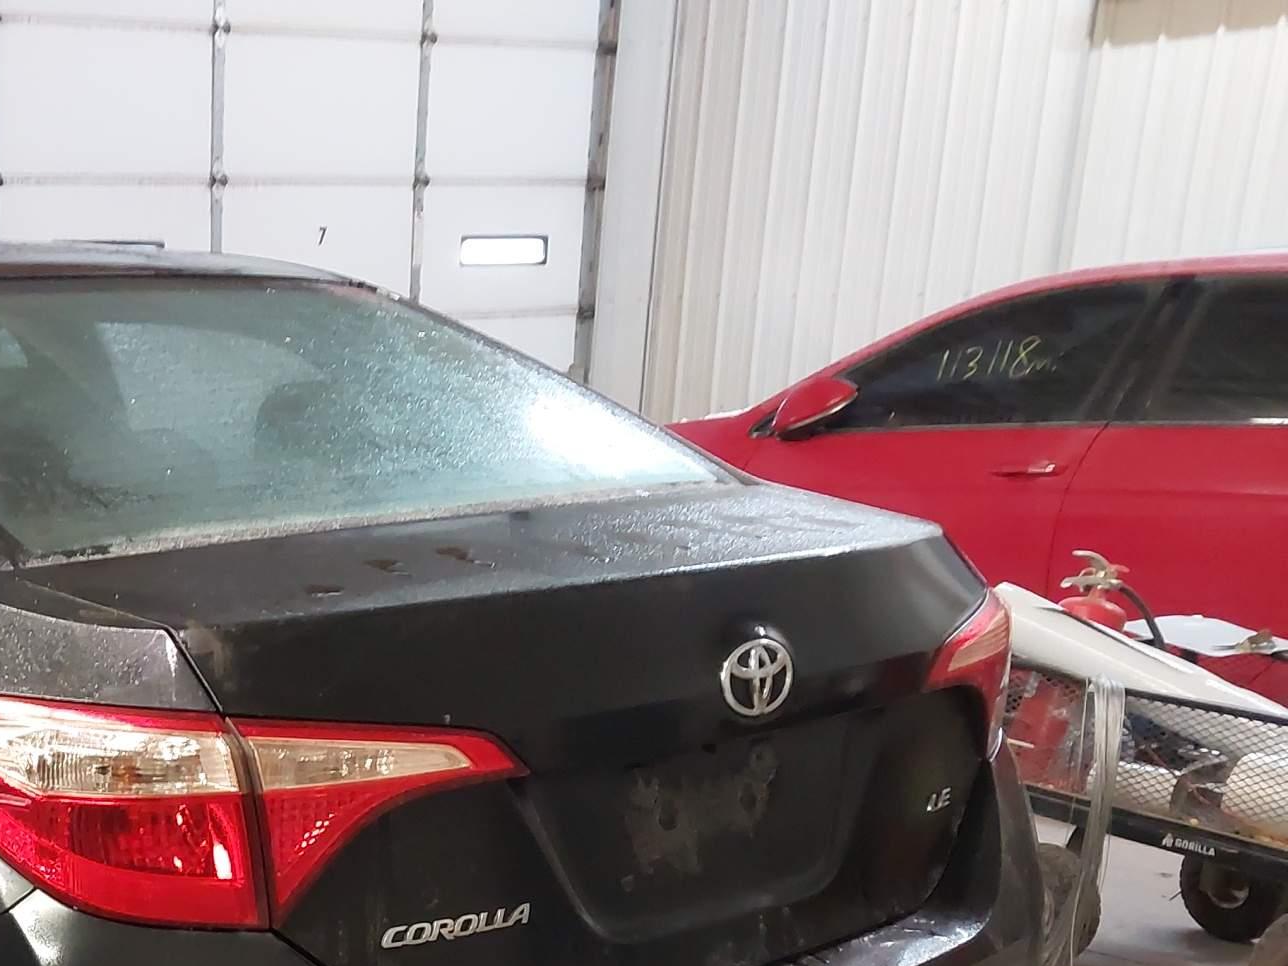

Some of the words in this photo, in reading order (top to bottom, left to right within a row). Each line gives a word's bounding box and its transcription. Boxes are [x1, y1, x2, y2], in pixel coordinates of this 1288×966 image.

[319, 226, 328, 246] 7
[926, 787, 952, 812] LE
[1174, 838, 1216, 857] GORILLA
[381, 902, 531, 949] COROLLA
